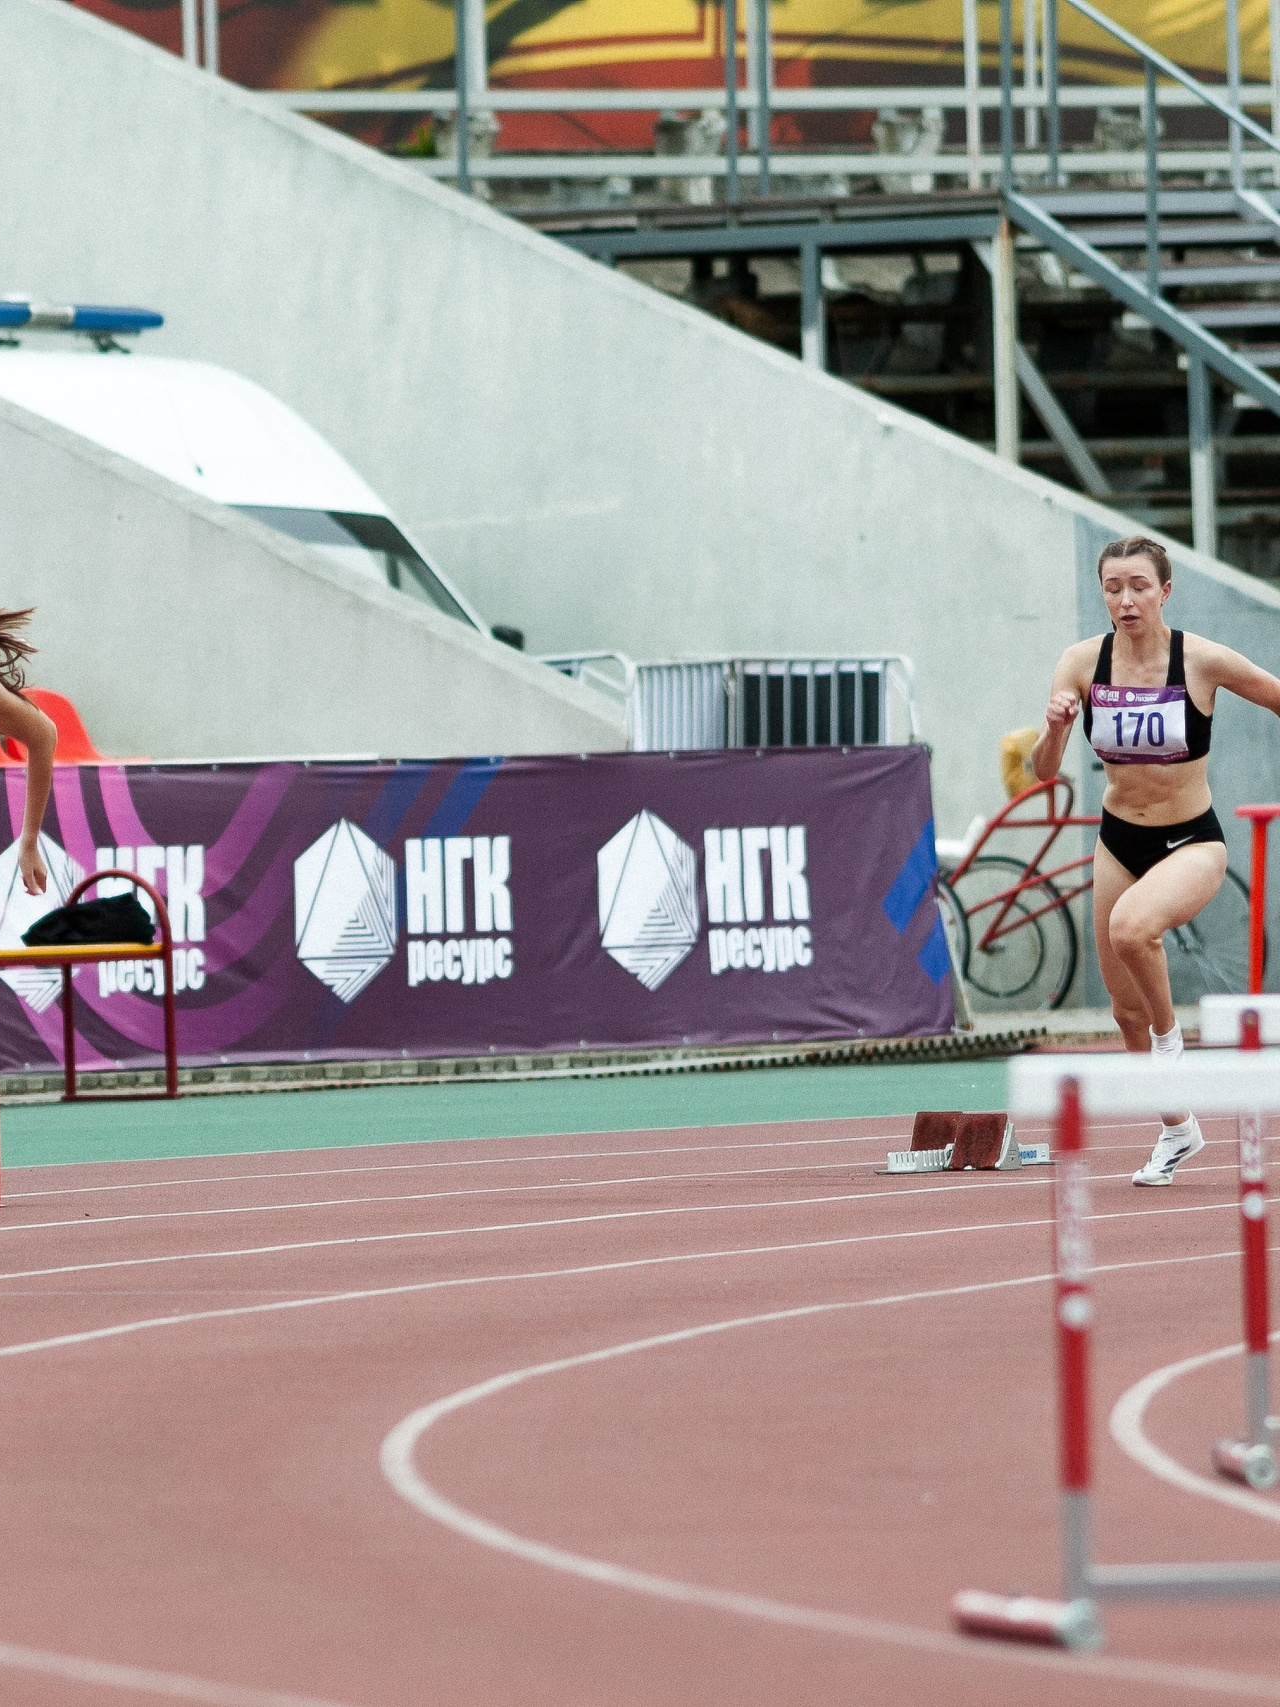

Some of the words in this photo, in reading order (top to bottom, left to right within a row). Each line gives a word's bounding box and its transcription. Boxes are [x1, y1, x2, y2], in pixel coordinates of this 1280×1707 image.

[1112, 711, 1165, 747] 170
[404, 835, 514, 934] НГК
[703, 825, 811, 923] НГК
[407, 936, 514, 987] ресурс
[707, 925, 814, 975] ресурс
